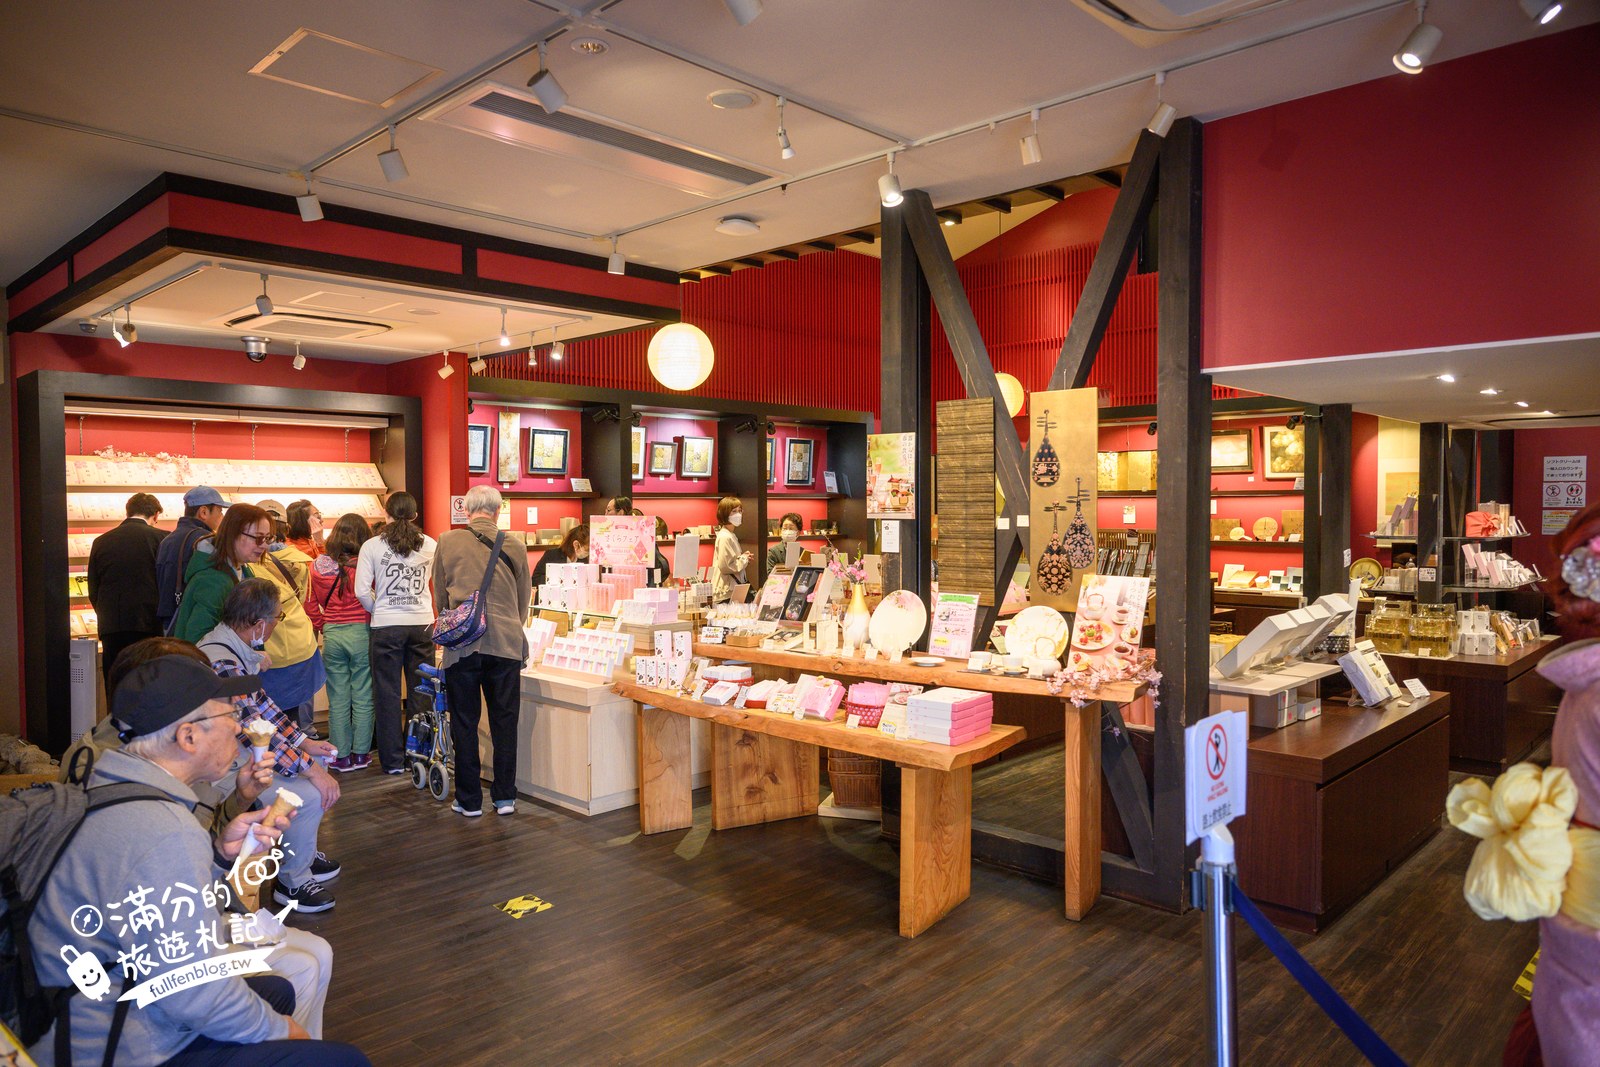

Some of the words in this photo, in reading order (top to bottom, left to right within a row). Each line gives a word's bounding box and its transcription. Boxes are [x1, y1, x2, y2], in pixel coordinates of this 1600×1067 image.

[604, 534, 639, 544] さくらフェア
